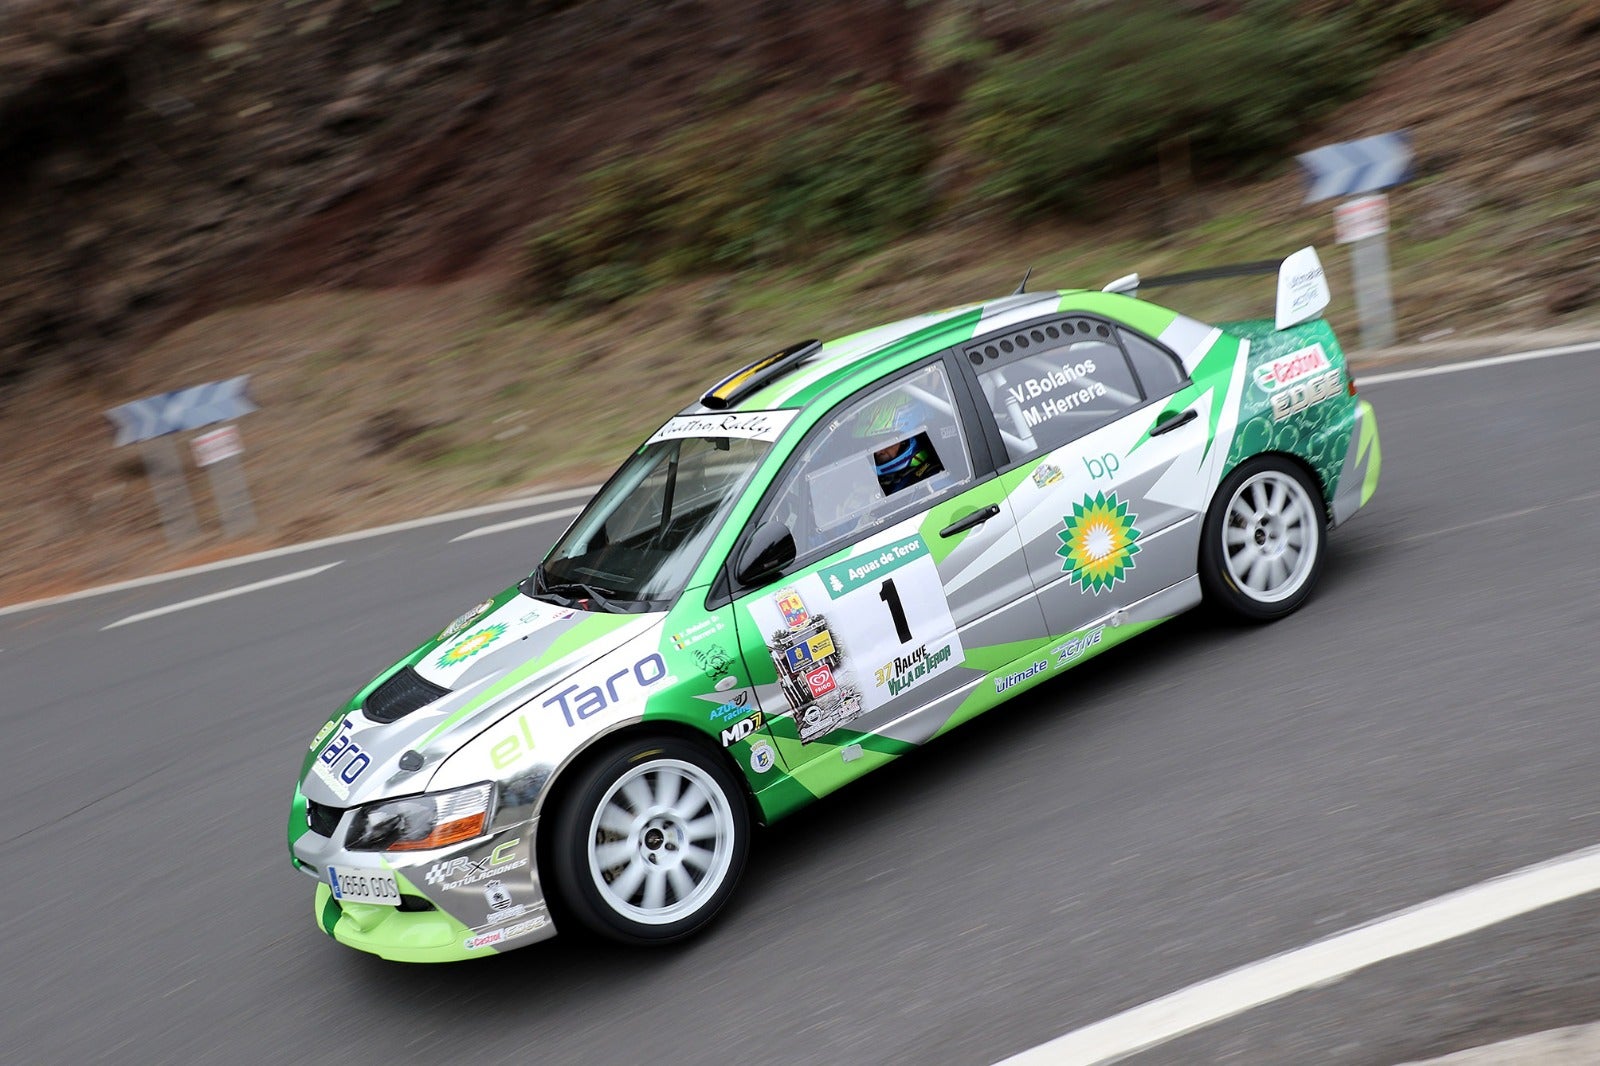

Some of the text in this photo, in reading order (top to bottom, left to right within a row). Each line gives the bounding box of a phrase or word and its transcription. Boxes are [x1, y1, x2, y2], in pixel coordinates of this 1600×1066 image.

[1008, 359, 1096, 403] V.Bolaños
[1022, 382, 1107, 428] M.Herrera
[1082, 452, 1119, 480] bp
[848, 540, 920, 580] Aguas de Teror
[879, 578, 912, 644] 1
[874, 661, 893, 687] 37
[997, 660, 1048, 693] ultimate
[1059, 629, 1103, 660] ACTIVE
[814, 682, 832, 694] FRIGO
[490, 652, 666, 770] el Taro
[721, 711, 762, 747] MD7
